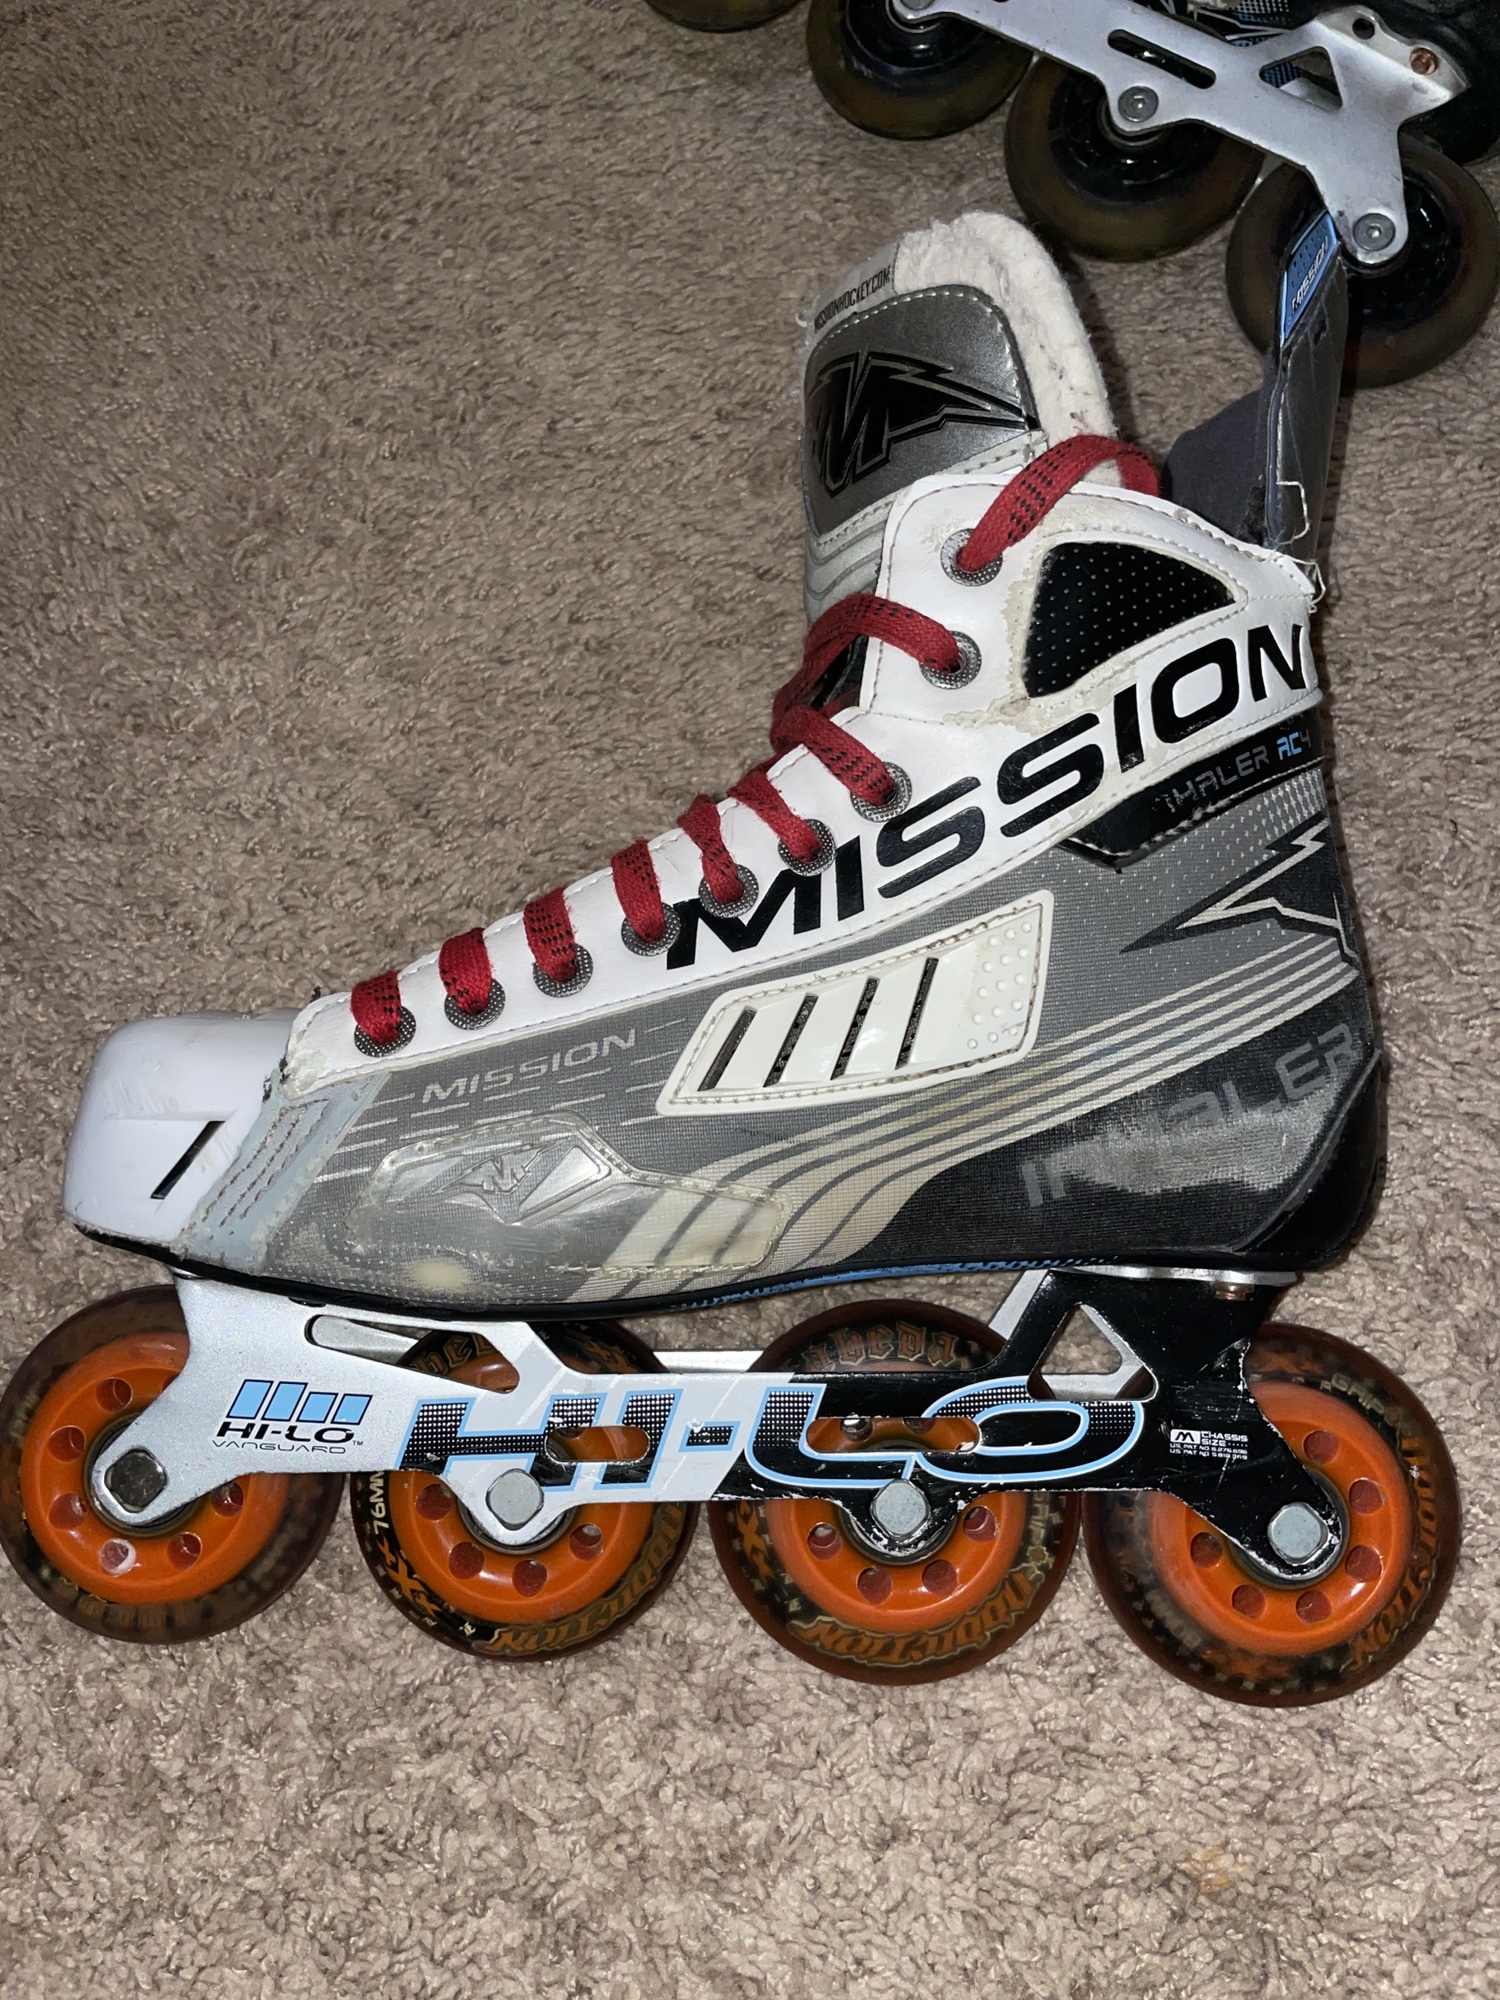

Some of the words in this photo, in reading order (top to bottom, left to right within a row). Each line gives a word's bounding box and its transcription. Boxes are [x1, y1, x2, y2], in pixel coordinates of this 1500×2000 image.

[666, 623, 1306, 970] MISSION
[422, 1028, 636, 1103] MISSION
[212, 1440, 346, 1455] VANGUARD
[216, 1421, 355, 1444] HI-LO
[394, 1374, 1145, 1492] HI-LO
[1201, 1431, 1248, 1442] CHASSIS
